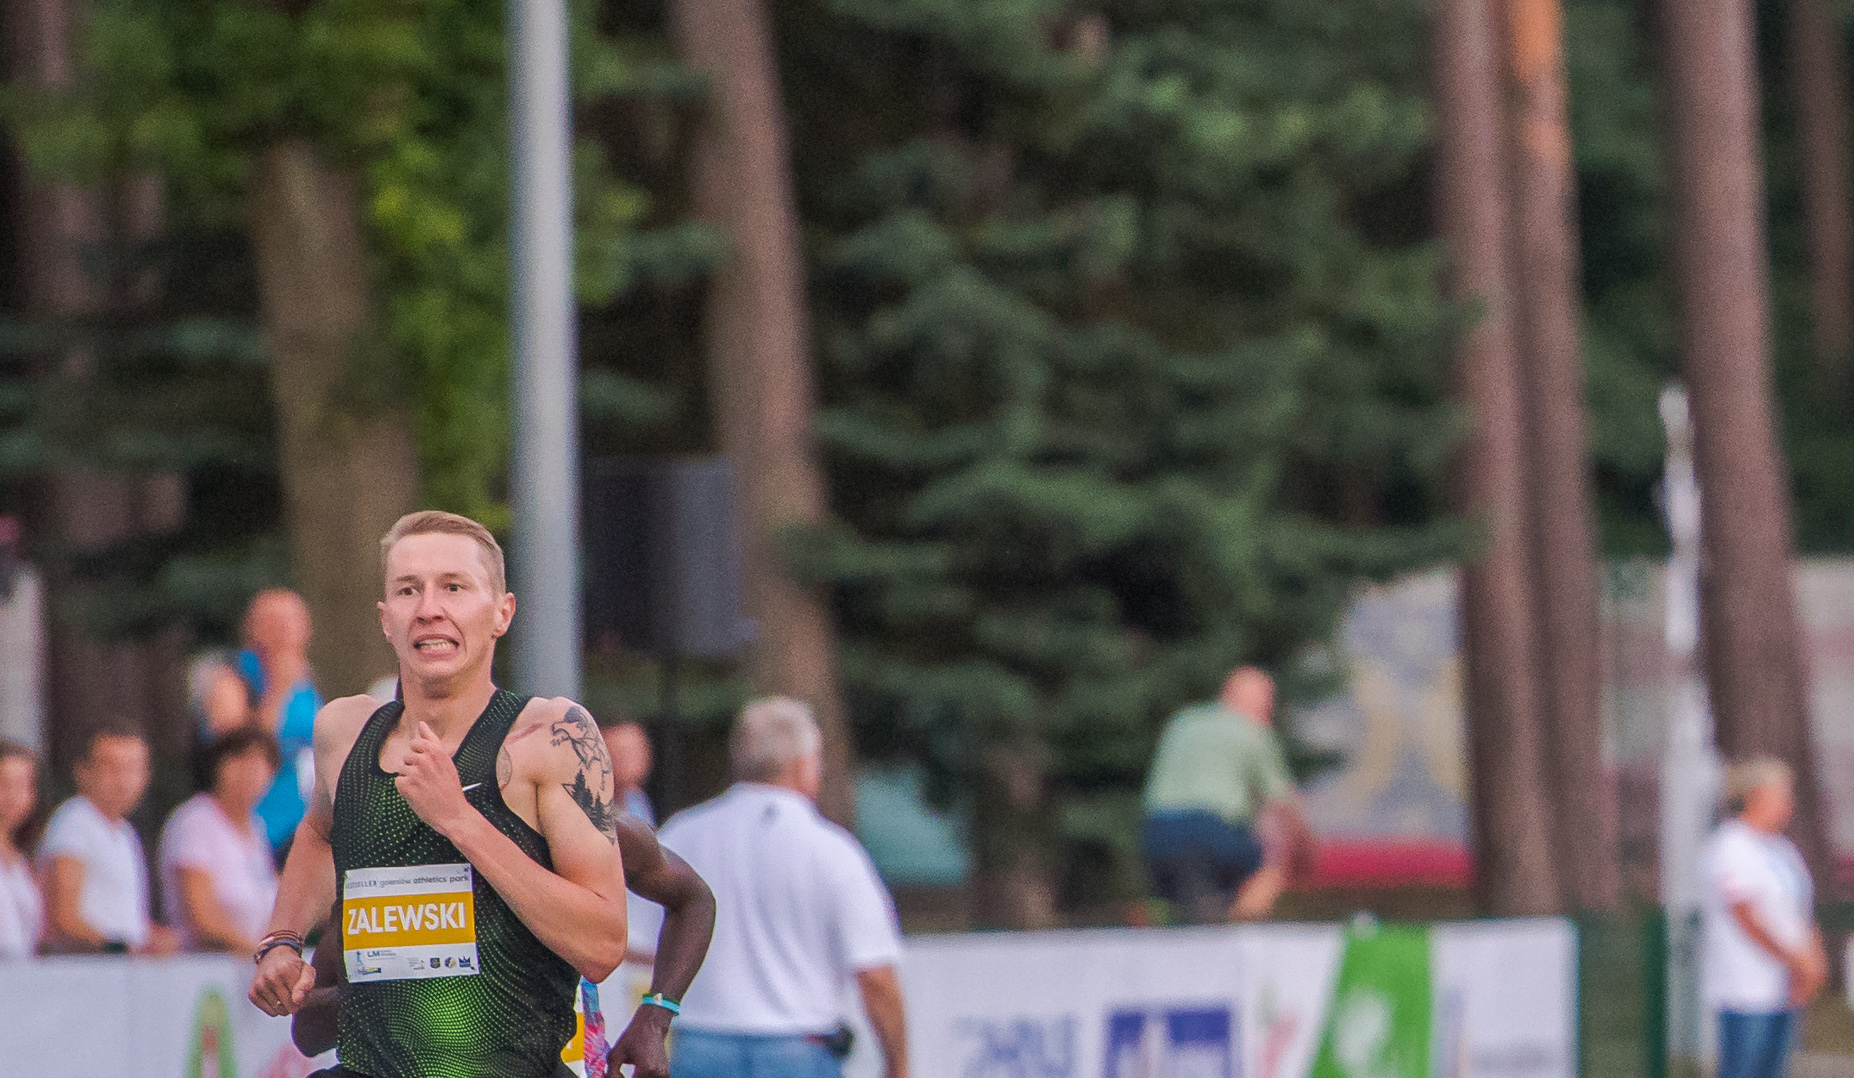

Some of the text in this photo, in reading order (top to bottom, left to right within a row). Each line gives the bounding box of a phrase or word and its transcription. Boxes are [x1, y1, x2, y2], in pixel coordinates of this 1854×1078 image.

[413, 876, 447, 885] athletics
[449, 874, 470, 883] park
[347, 902, 467, 936] ZALEWSKI
